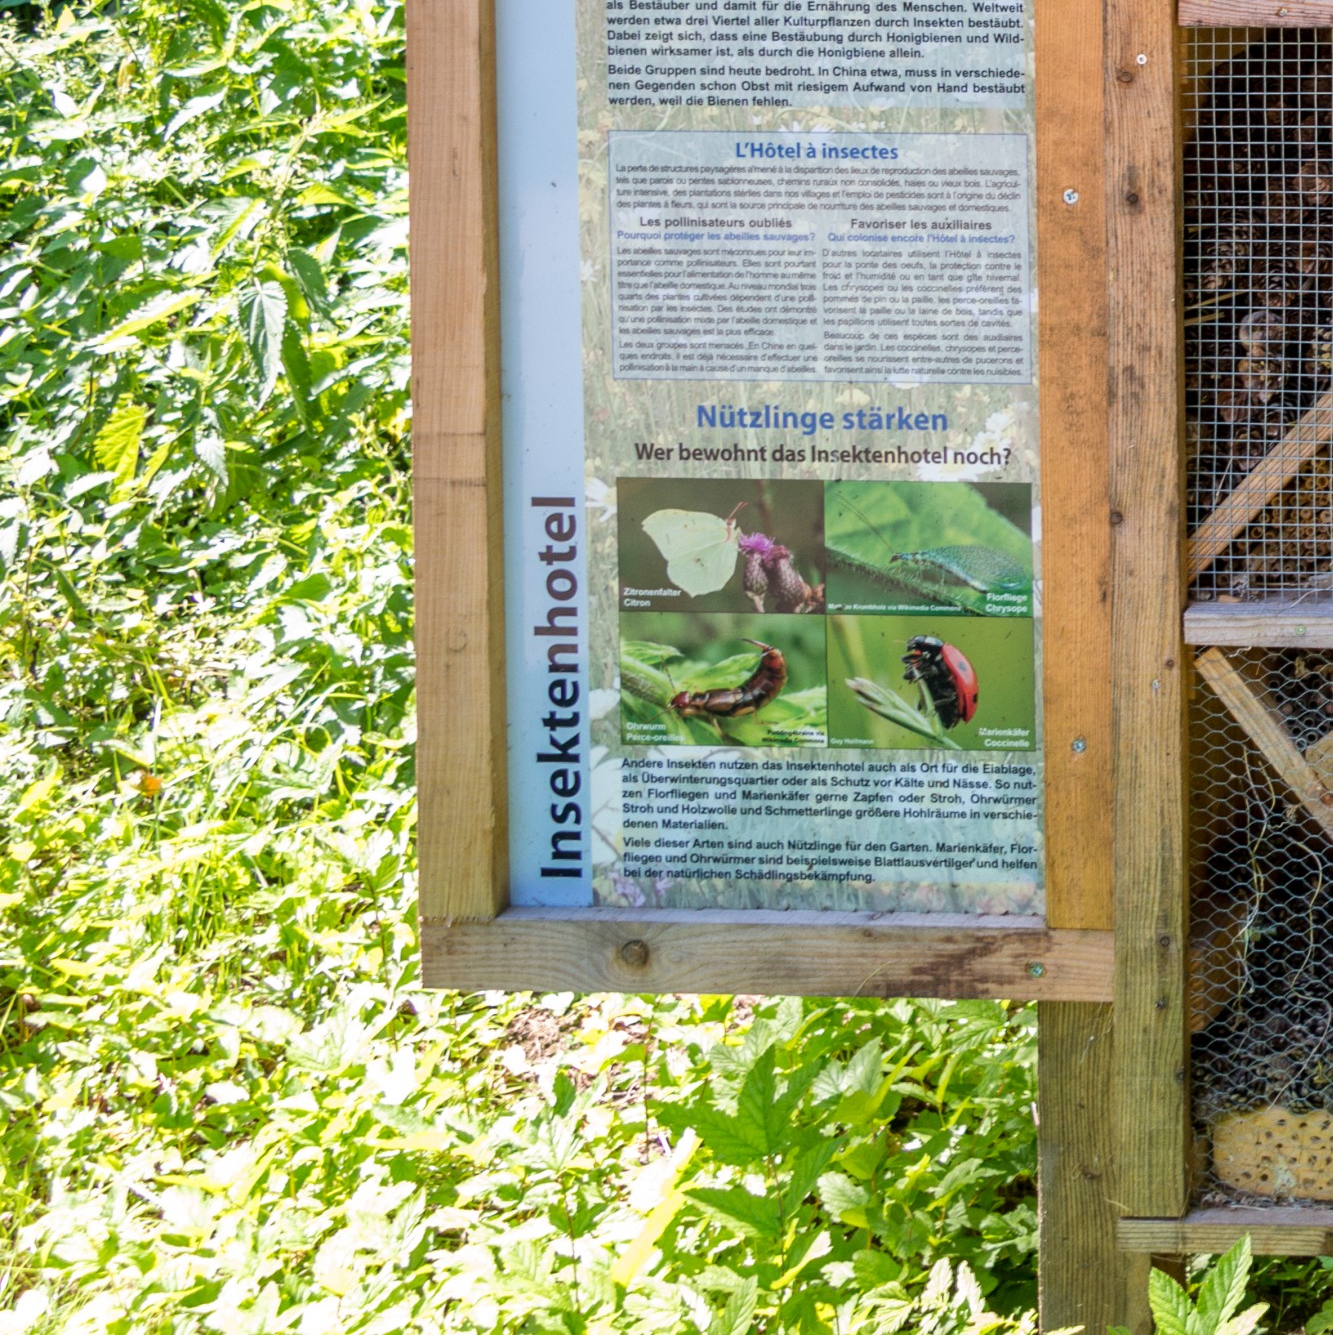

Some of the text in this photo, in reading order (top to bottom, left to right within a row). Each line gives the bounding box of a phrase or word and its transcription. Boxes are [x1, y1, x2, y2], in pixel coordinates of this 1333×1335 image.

[608, 95, 793, 107] werden, weil die Bienen fehlen.
[805, 142, 817, 159] à
[821, 143, 898, 160] insectes
[639, 215, 793, 230] Les pollinisateurs oubliés
[850, 218, 992, 230] Favoriser les auxiliaires
[696, 404, 949, 435] Nützlinge stärken
[634, 442, 1012, 465] Wer bewohnt das Insektenhotel noch?
[623, 587, 682, 597] Zitronenfalter
[623, 598, 651, 607] Citron
[985, 604, 1028, 613] Chrysope
[531, 496, 583, 878] Insektenhotel
[984, 738, 1030, 747] Coccinelle
[621, 758, 1037, 777] Andere Insekten nutzen das Insektenhotel auch als Ort für die Eiablage,
